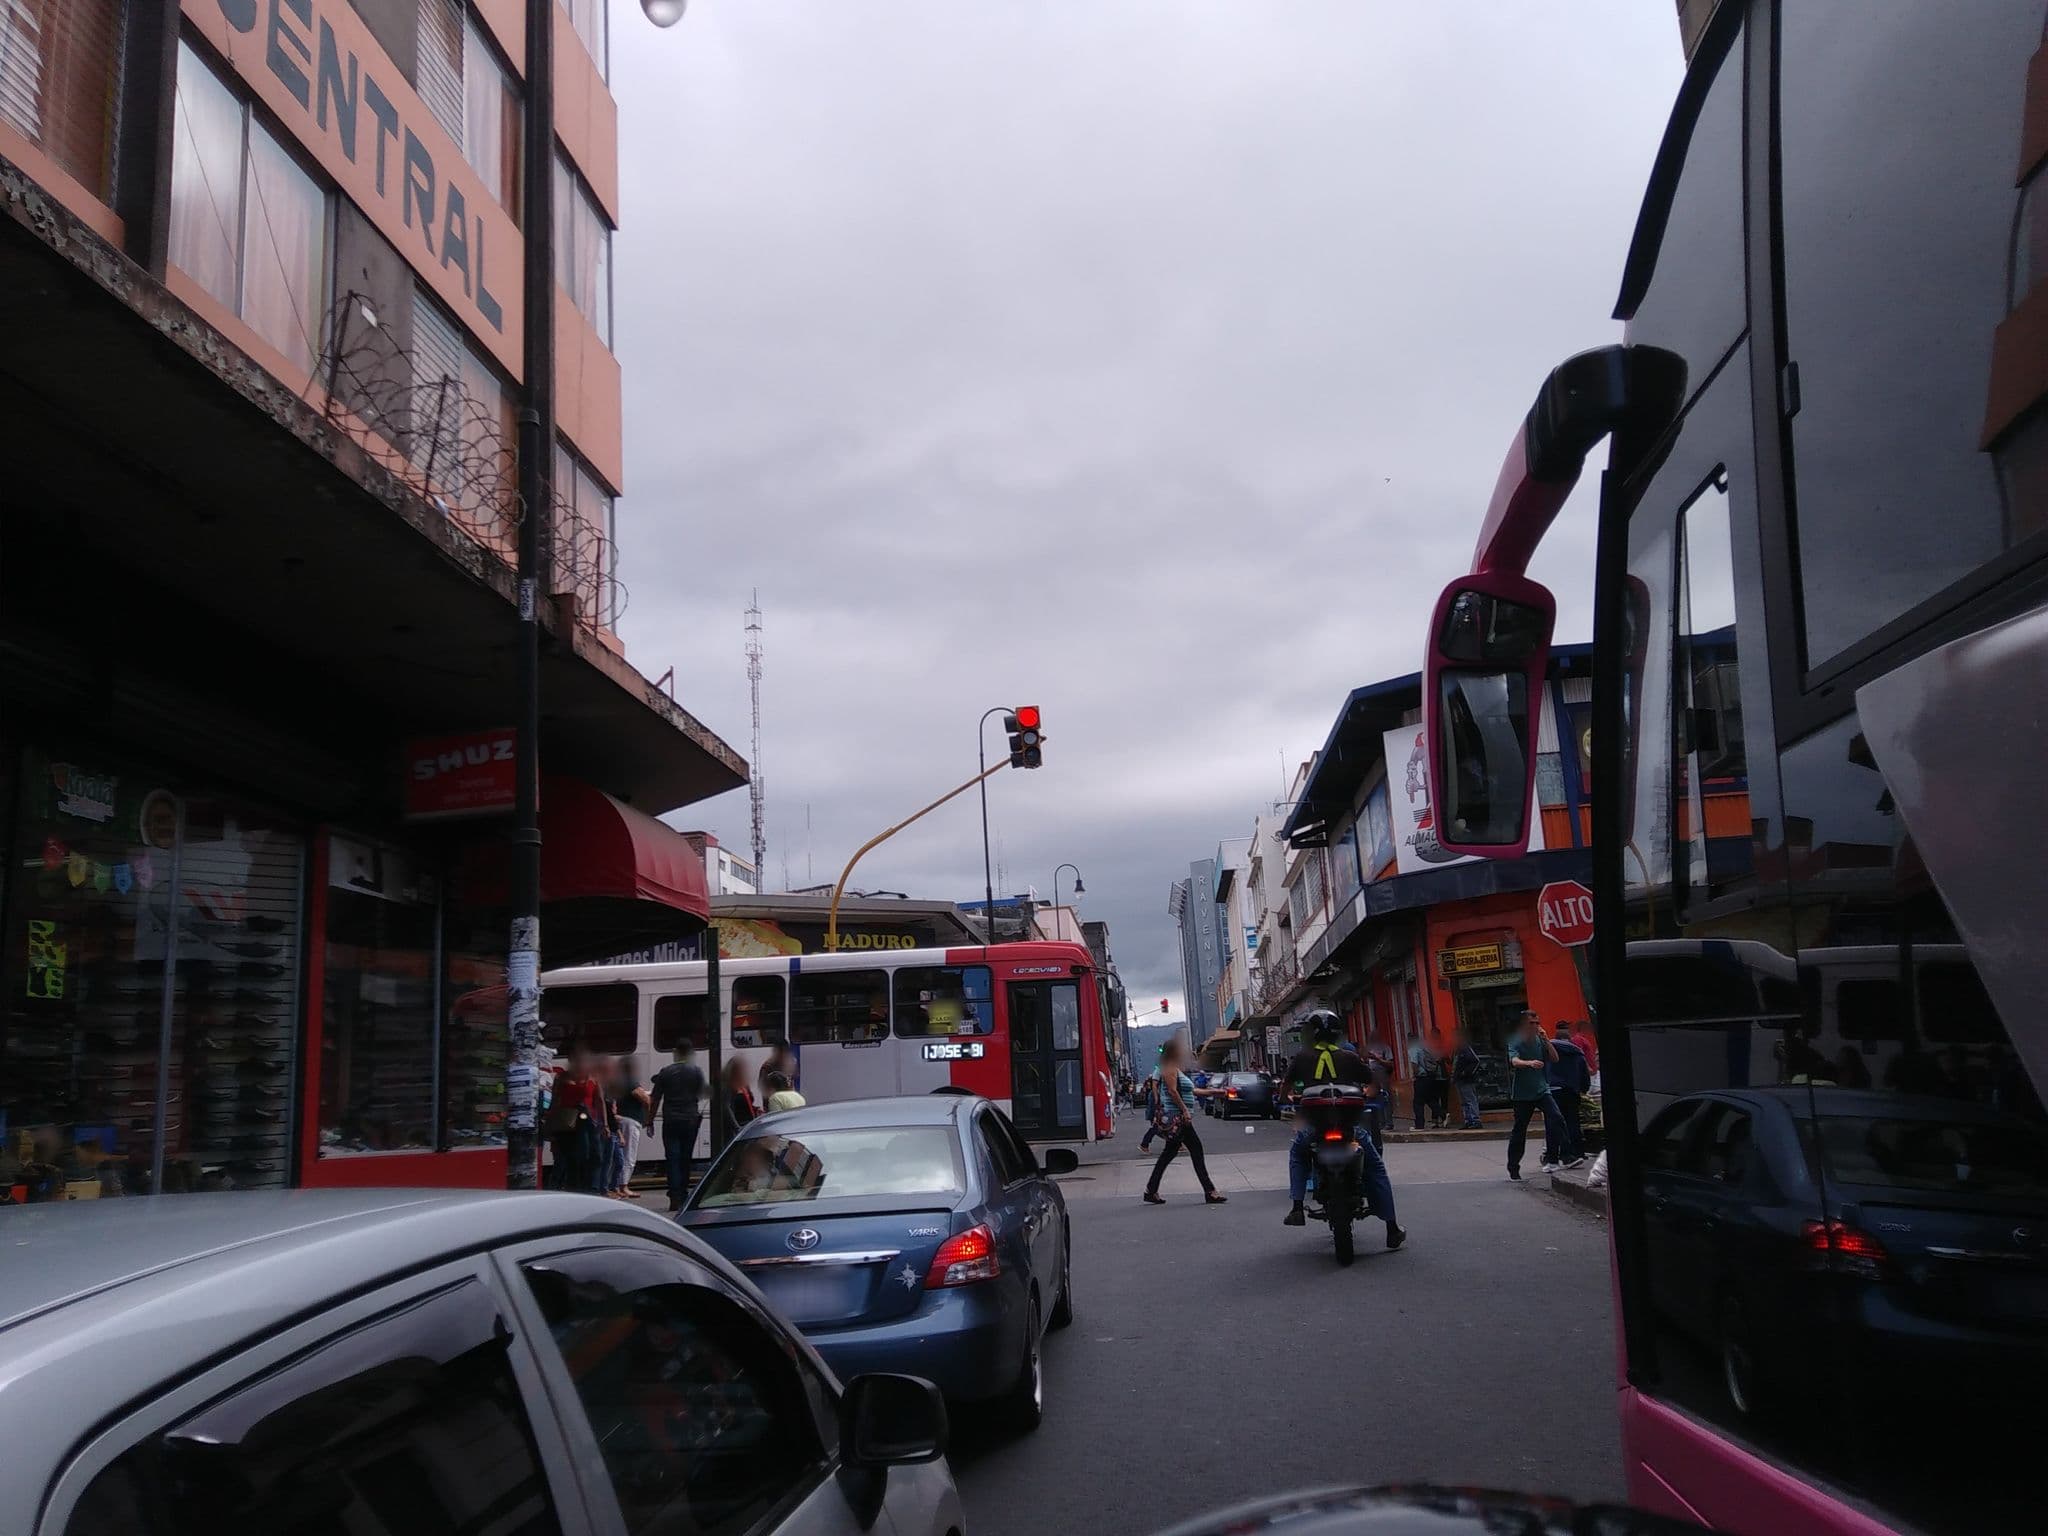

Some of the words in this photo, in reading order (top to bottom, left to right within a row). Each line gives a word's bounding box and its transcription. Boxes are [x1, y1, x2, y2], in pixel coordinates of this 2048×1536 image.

[216, 0, 503, 334] ENTRAL
[413, 739, 515, 780] SHUZ
[1543, 895, 1594, 931] ALTO
[823, 932, 917, 949] MADURO
[1198, 875, 1217, 1001] RAVENTOS
